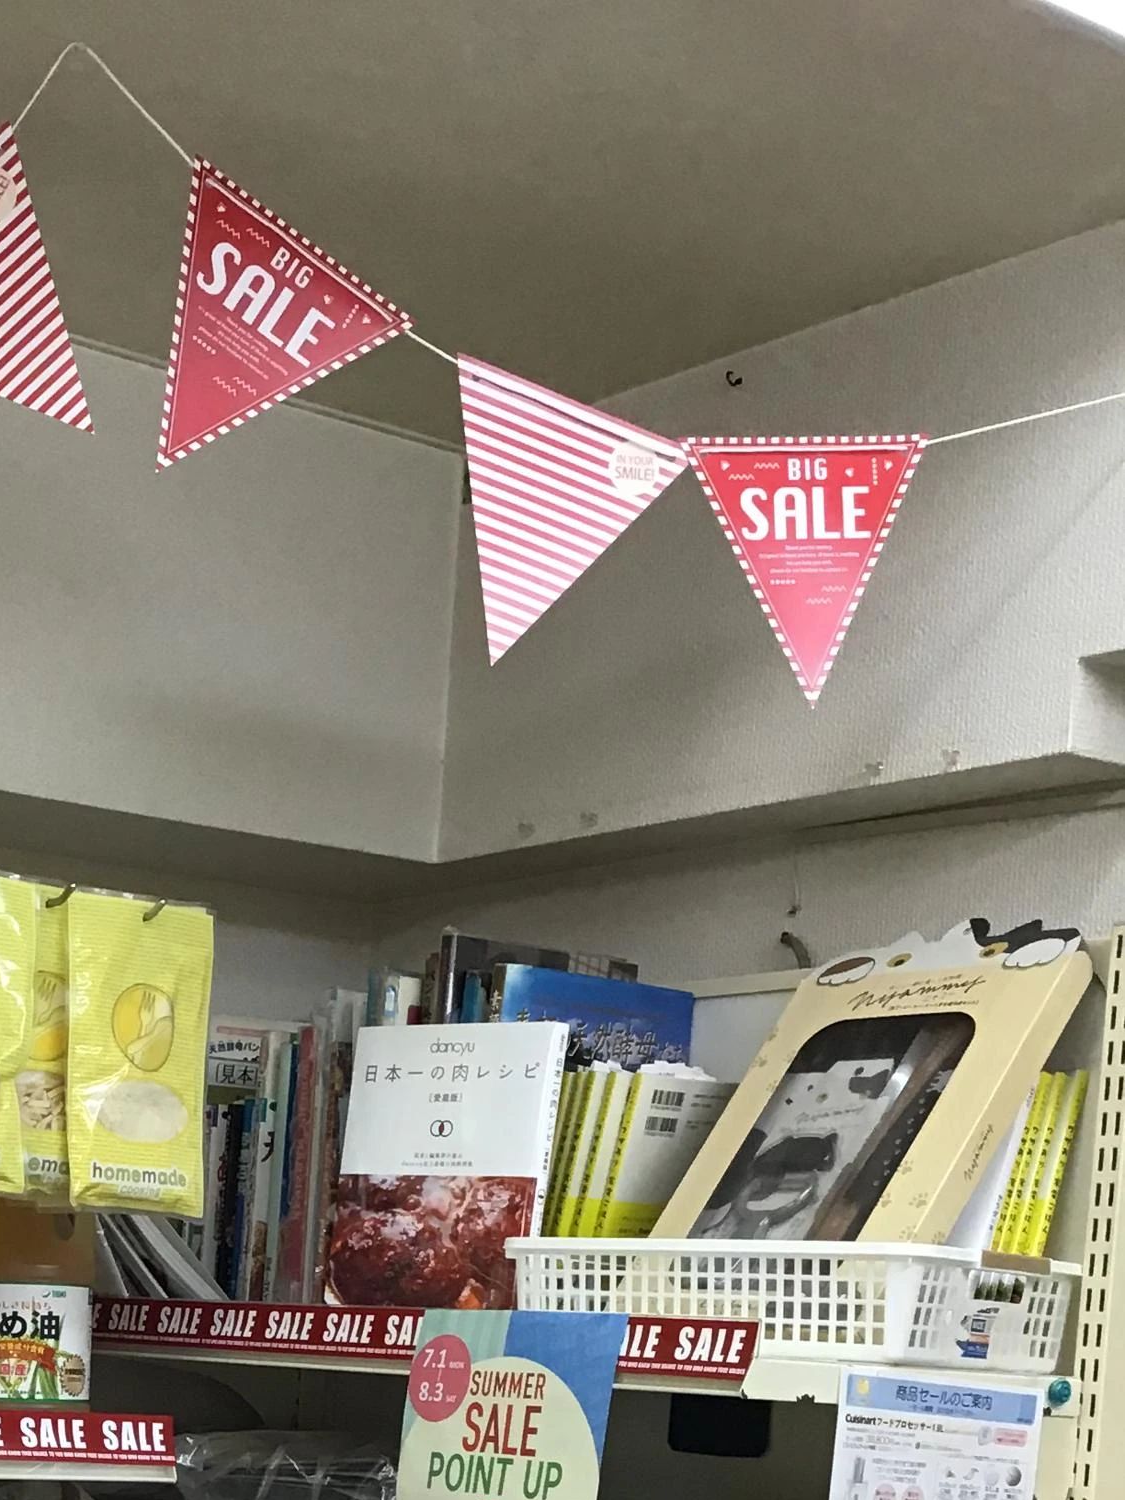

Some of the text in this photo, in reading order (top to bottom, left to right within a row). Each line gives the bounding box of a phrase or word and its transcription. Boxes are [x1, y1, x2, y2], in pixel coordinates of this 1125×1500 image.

[270, 246, 314, 288] BIG
[196, 242, 336, 368] SALE
[788, 458, 827, 481] BIG
[740, 486, 871, 540] SALE
[365, 1063, 541, 1083] 日本一の肉レシピ
[92, 1162, 186, 1187] homemade
[108, 1304, 747, 1364] SALE SALE SALE SALE
[423, 1349, 447, 1368] 7.1
[418, 1381, 444, 1402] 8.3
[470, 1371, 546, 1399] SUMMER
[102, 1420, 166, 1451] SALE
[462, 1402, 541, 1456] SALE
[427, 1452, 562, 1500] POINT UP
